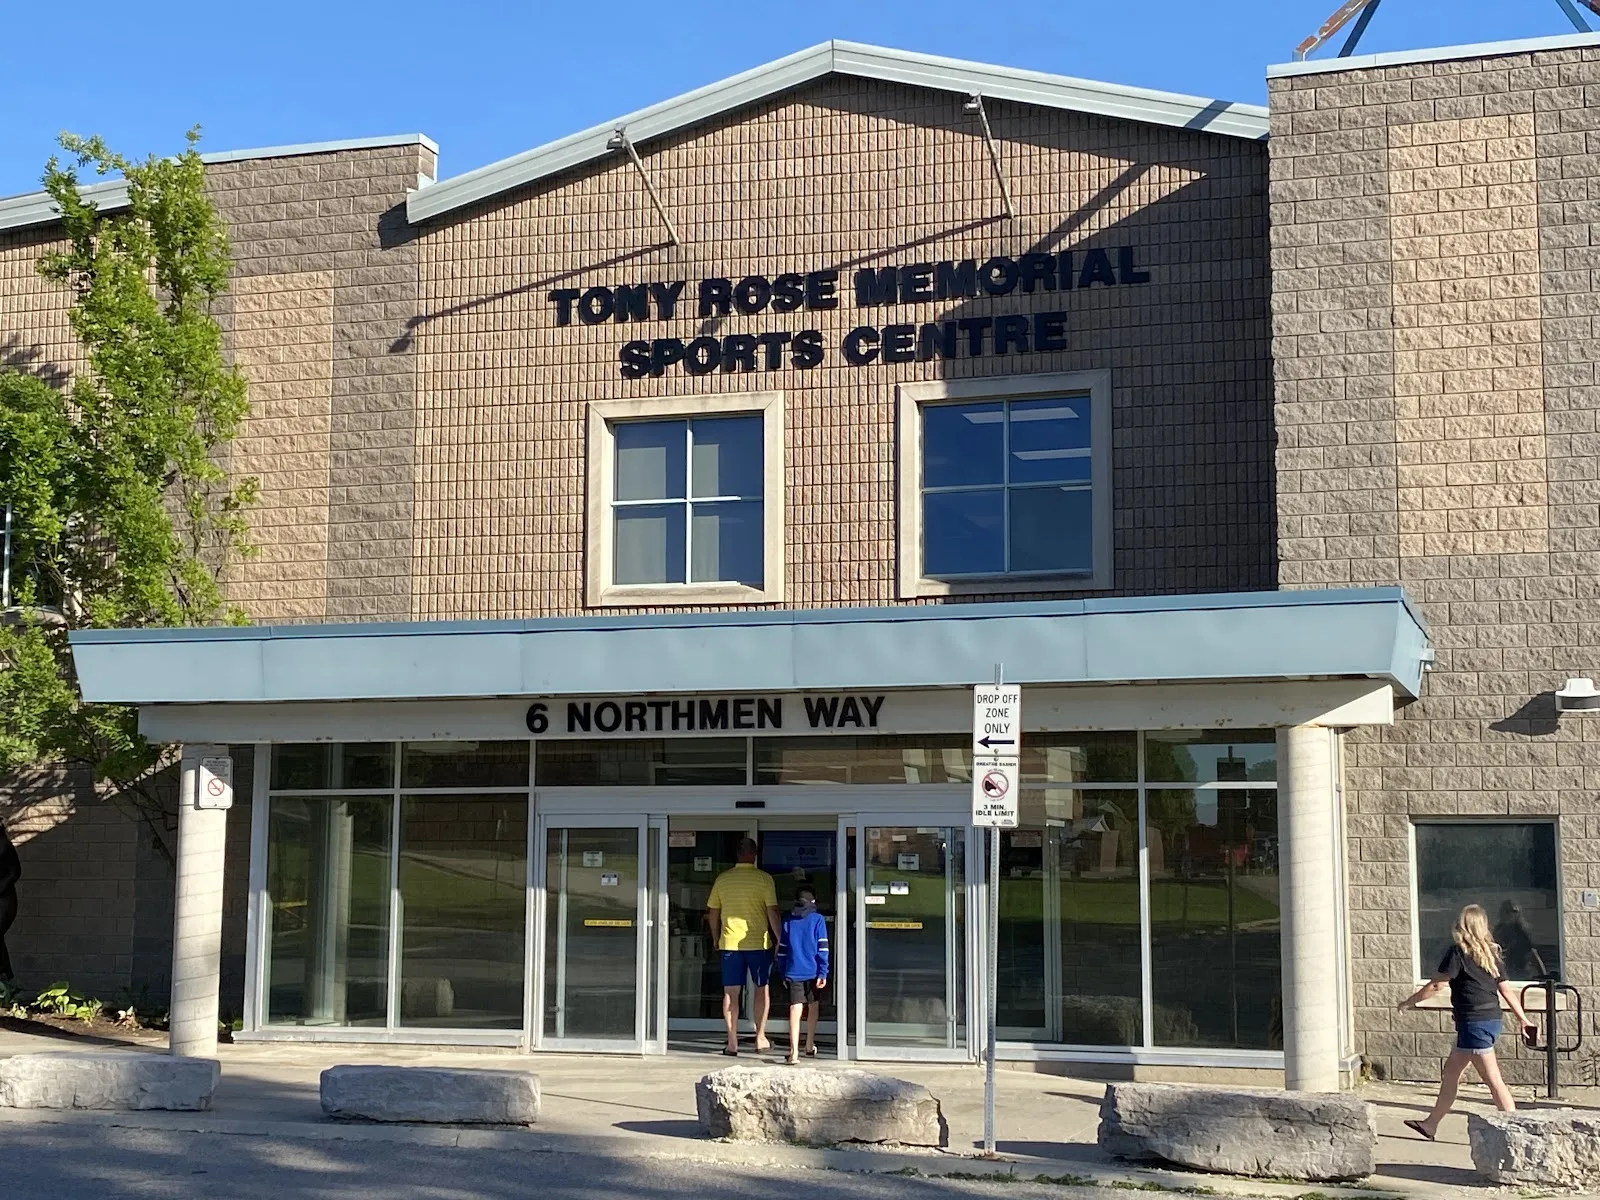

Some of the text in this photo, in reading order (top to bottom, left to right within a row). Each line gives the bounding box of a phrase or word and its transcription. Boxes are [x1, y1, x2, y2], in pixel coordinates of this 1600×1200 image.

[547, 245, 1150, 327] TONY ROSE MEMORIAL
[619, 310, 1067, 380] SPORTS CENTRE
[977, 694, 1018, 704] DROP OFF
[525, 695, 885, 734] 6 NORTHMEN WAY
[985, 707, 1009, 718] ZONE
[984, 723, 1010, 734] ONLY
